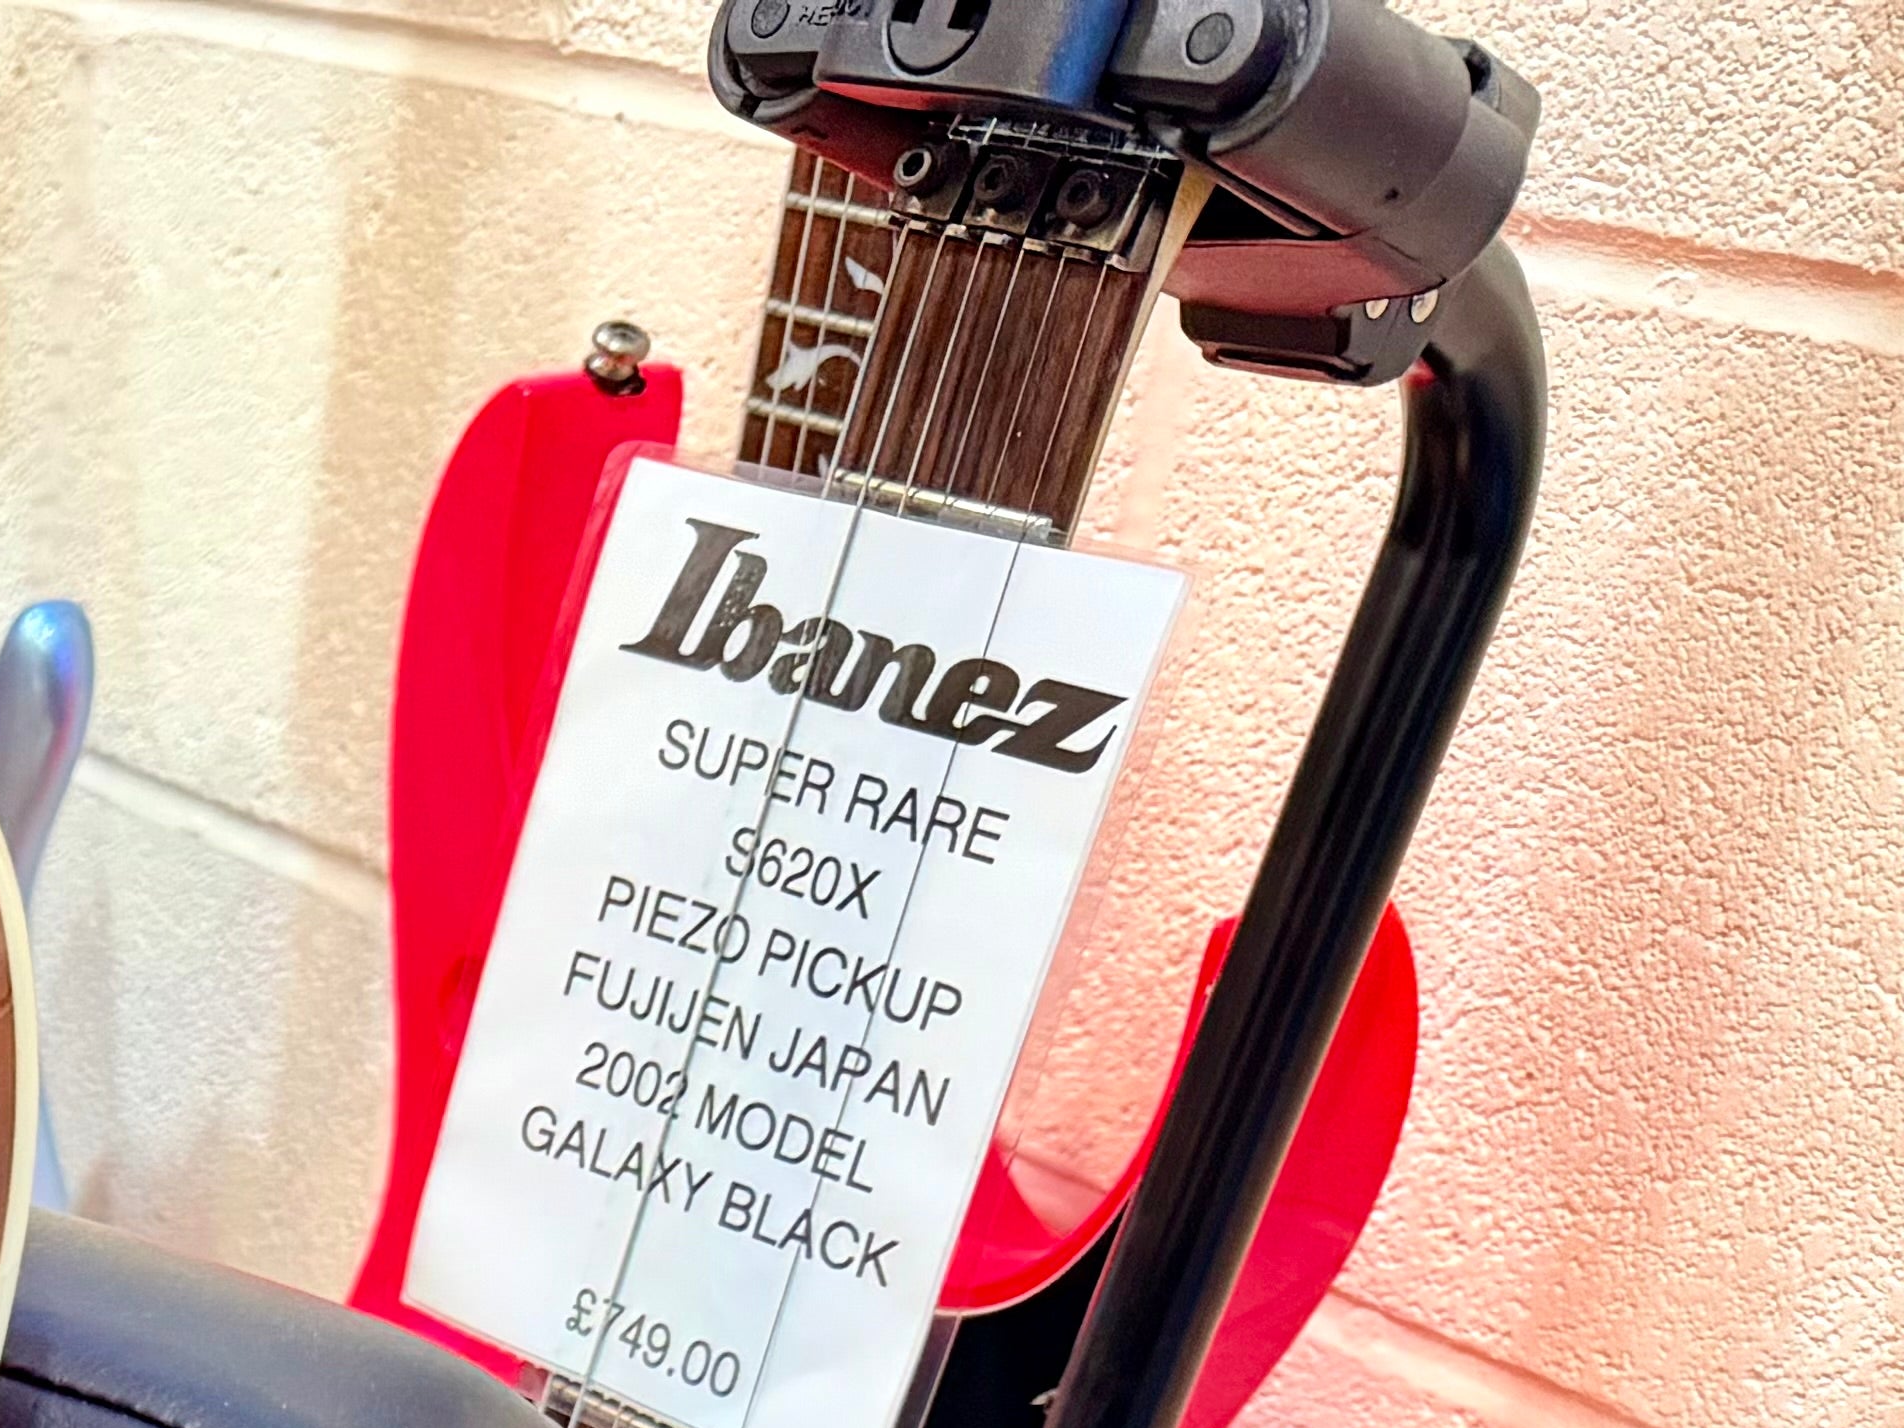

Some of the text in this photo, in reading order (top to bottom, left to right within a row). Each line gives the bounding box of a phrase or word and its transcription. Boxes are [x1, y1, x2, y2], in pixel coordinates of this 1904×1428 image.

[619, 518, 1129, 773] Ibanez
[658, 720, 1009, 865] SUPER RARE
[725, 829, 882, 919] S620X
[597, 876, 963, 1032] PIEZO PICKUP
[563, 951, 951, 1126] FUJIJEN JAPAN
[576, 1043, 875, 1193] 2002 MODEL
[521, 1106, 900, 1288] GALAXY BLACK
[564, 1287, 740, 1399] £749.00
